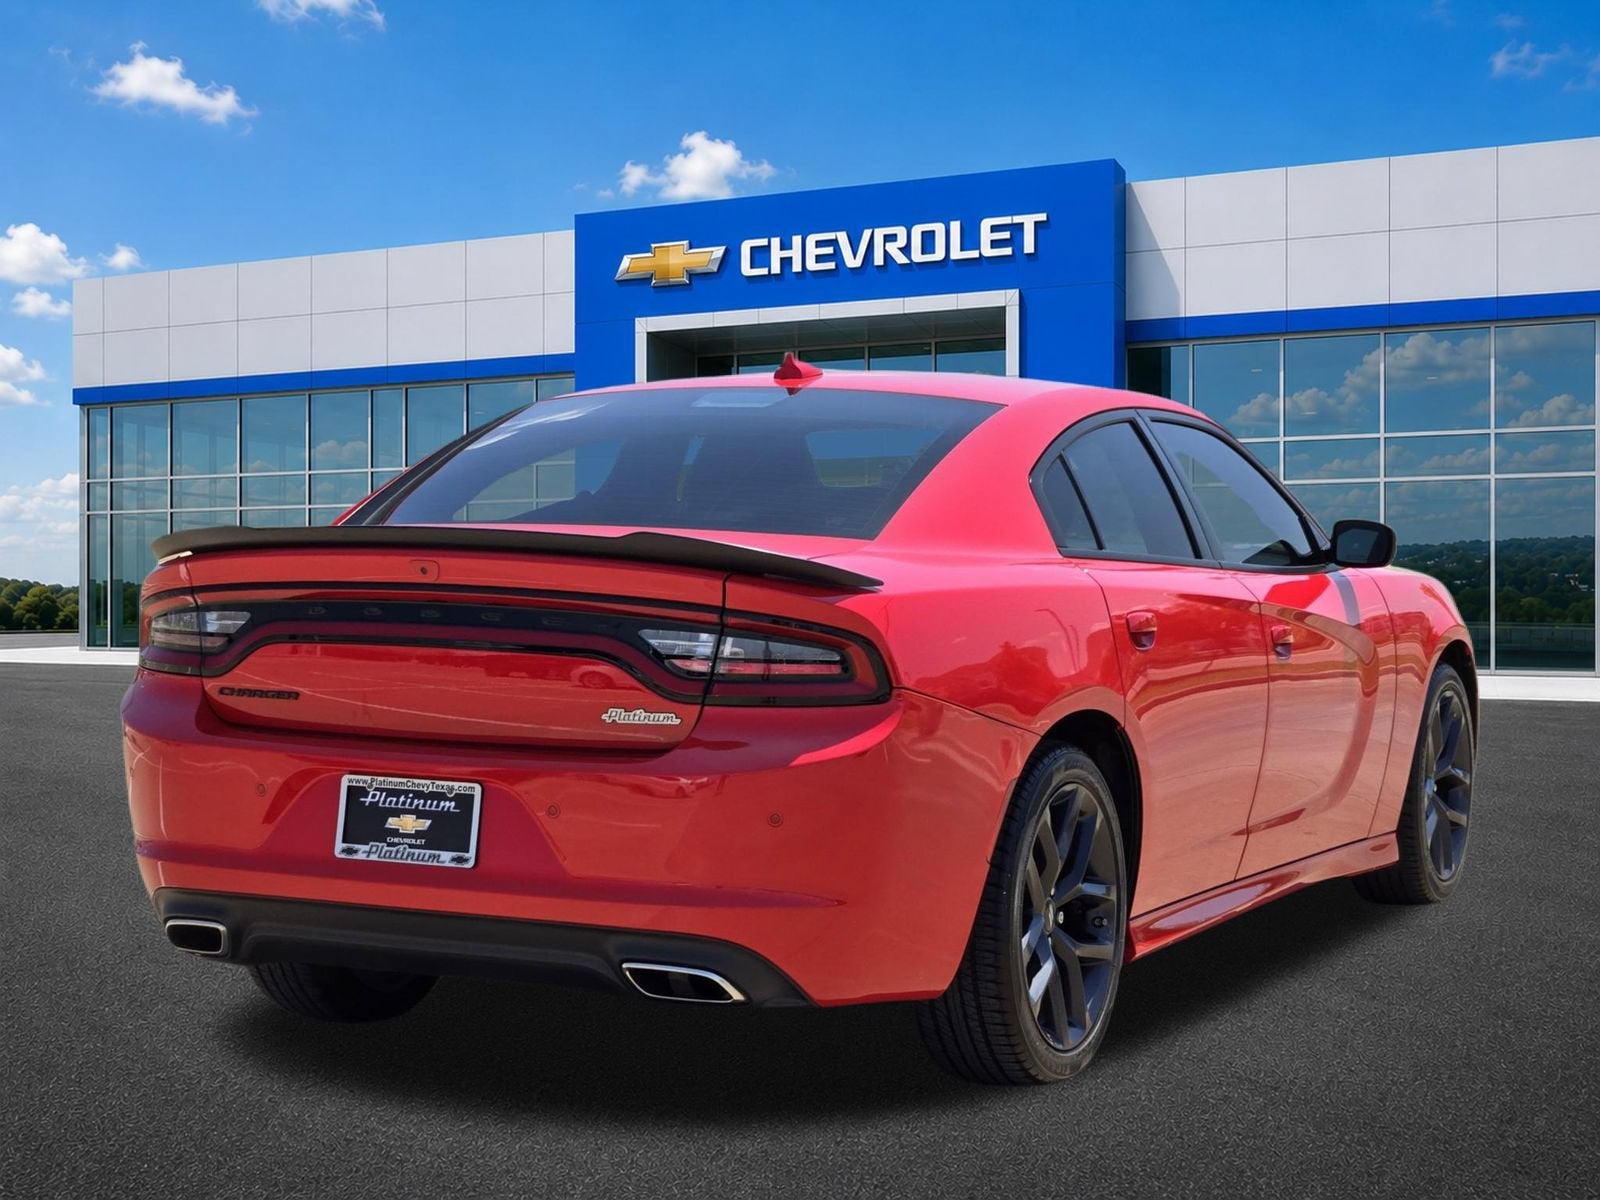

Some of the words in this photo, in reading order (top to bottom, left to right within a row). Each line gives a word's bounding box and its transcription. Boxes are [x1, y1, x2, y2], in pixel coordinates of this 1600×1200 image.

[740, 212, 1048, 277] CHEVROLET
[219, 687, 300, 700] CHARGER
[601, 708, 681, 725] Platinum
[360, 791, 461, 812] Platinum
[387, 836, 426, 845] CHEVROLET
[362, 843, 446, 864] Platinum
